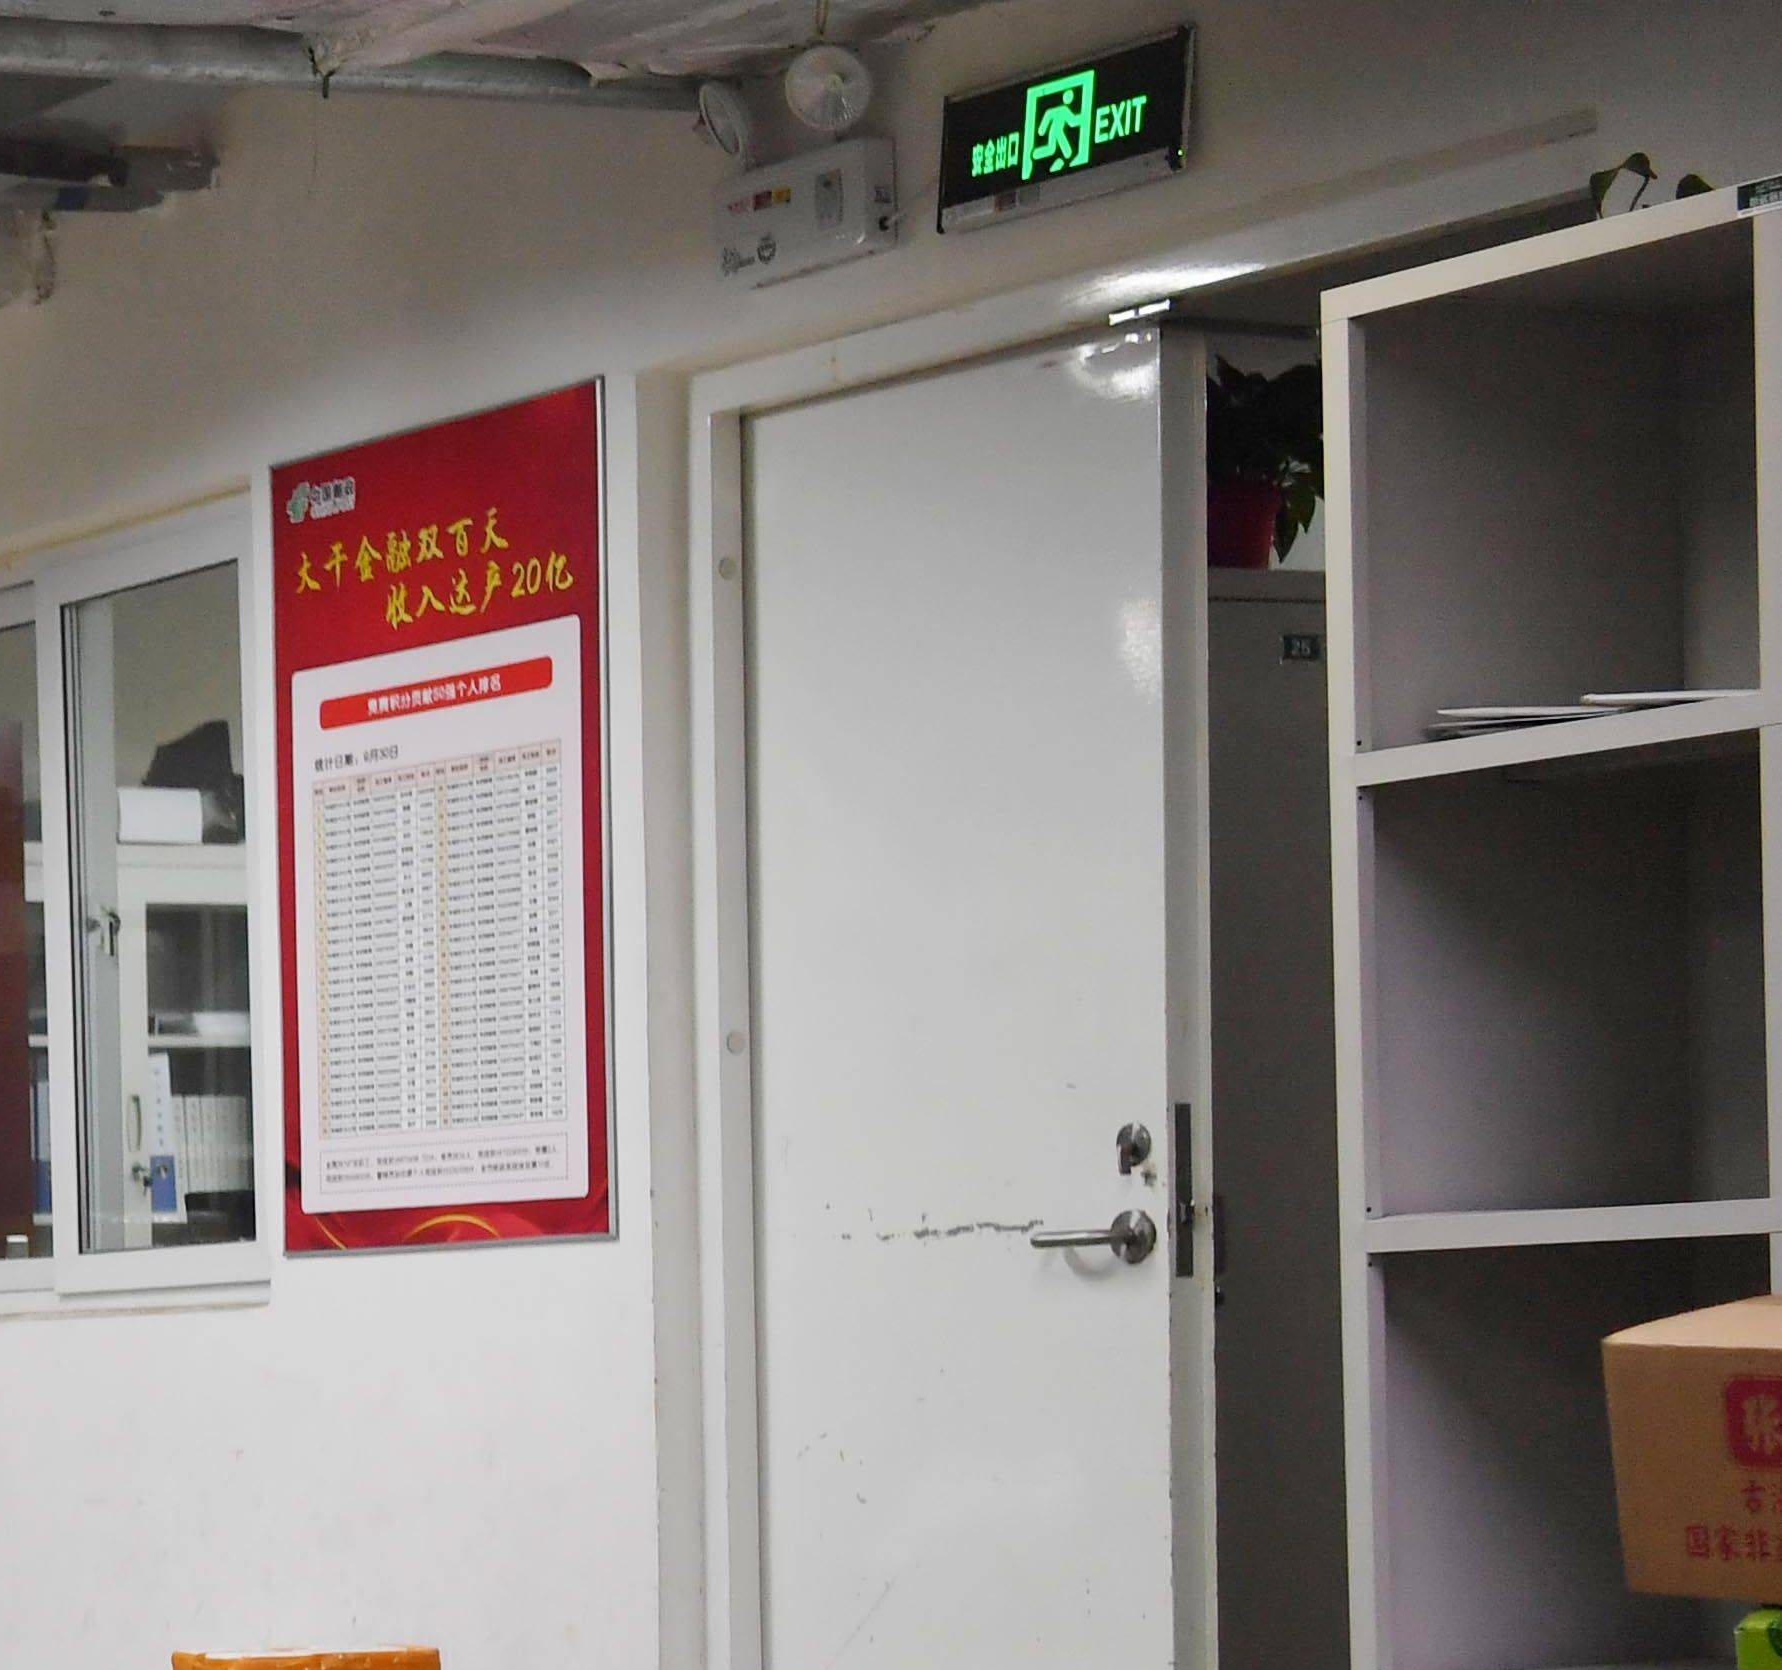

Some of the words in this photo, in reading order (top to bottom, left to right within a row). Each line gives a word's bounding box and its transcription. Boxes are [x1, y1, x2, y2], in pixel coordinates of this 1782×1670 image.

[1094, 95, 1147, 144] EXIT
[971, 132, 1019, 177] 安全出口
